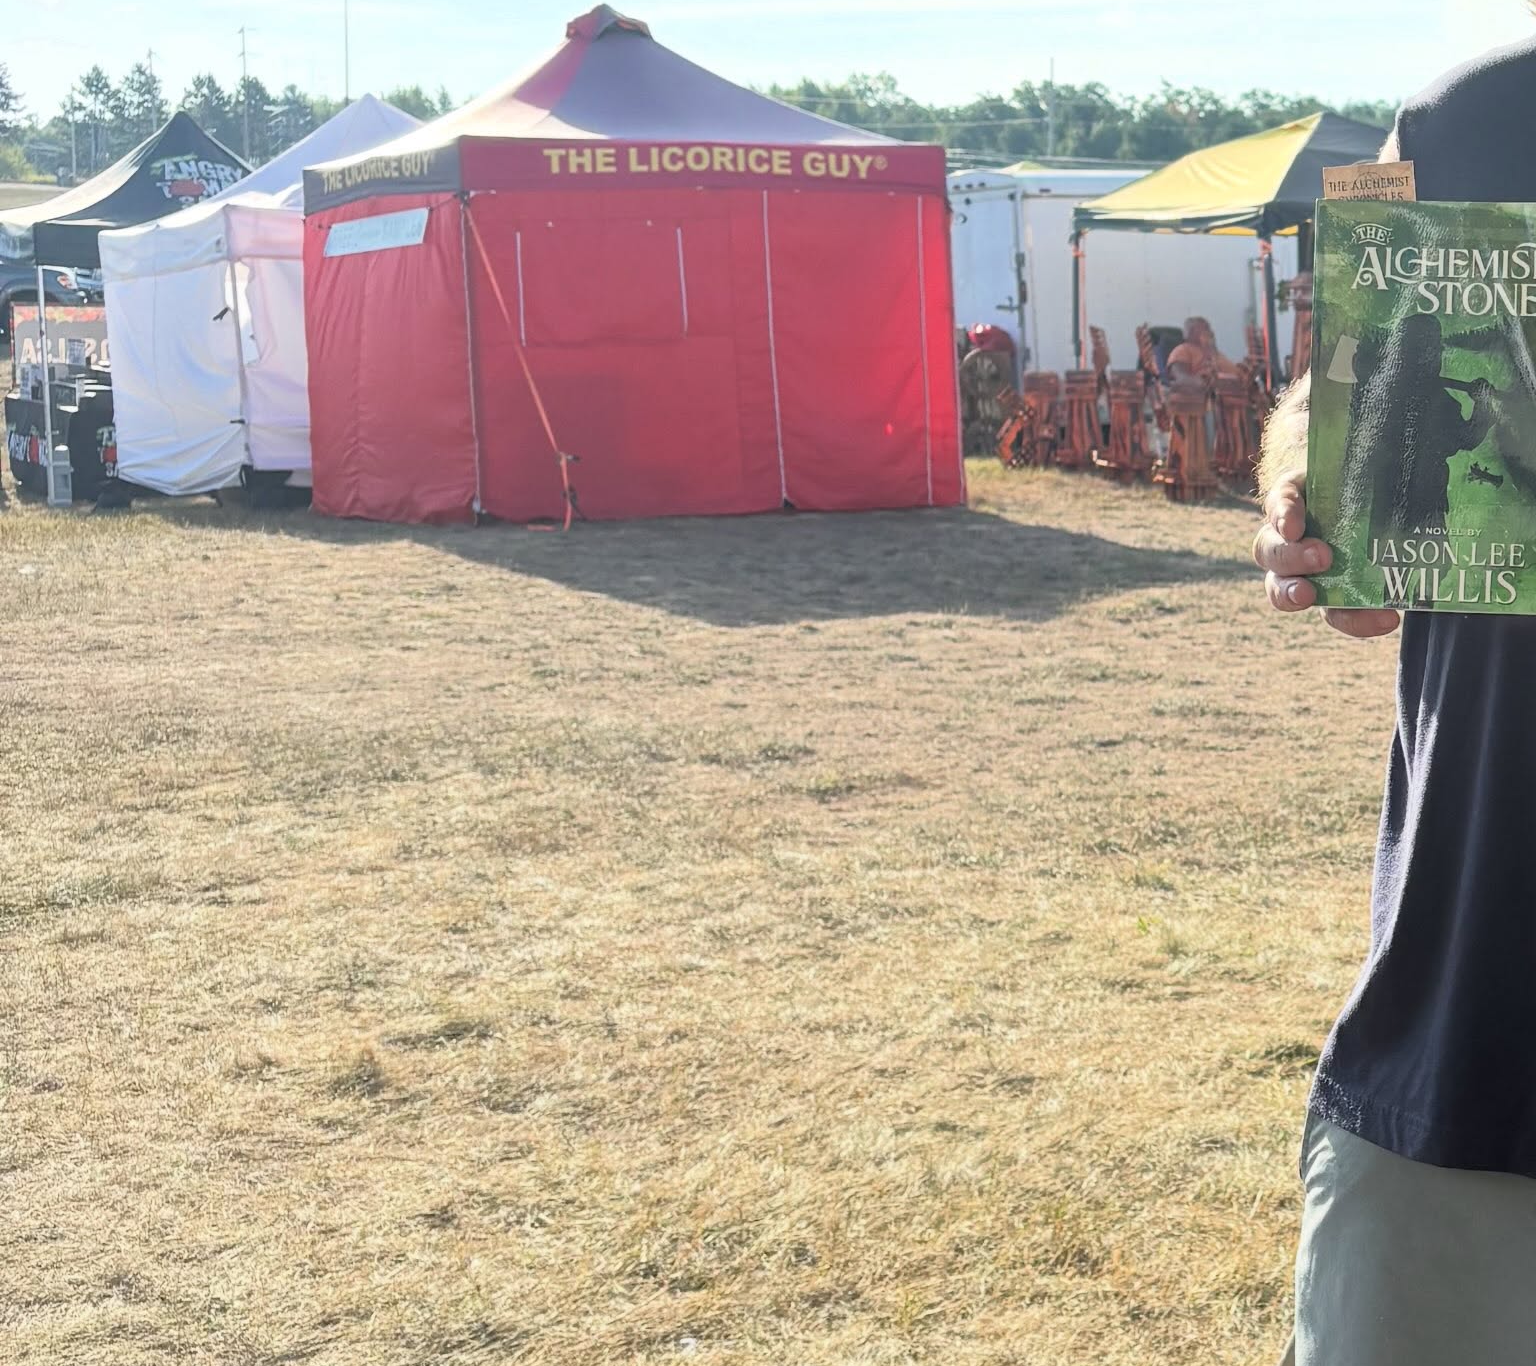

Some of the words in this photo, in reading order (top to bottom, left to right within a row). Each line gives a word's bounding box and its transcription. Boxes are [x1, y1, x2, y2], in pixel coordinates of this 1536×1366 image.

[322, 170, 343, 195] THE
[345, 156, 399, 187] LICORICE
[402, 151, 431, 176] GUY
[543, 148, 617, 173] THE
[628, 147, 792, 175] LICORICE
[1328, 181, 1348, 192] THE
[1351, 176, 1410, 191] ALCHEMIST
[1356, 227, 1387, 241] THE
[1426, 527, 1462, 535] NOVEL
[1371, 539, 1459, 566] JASON
[1469, 542, 1525, 567] LEE
[1382, 567, 1517, 604] WILLIS
